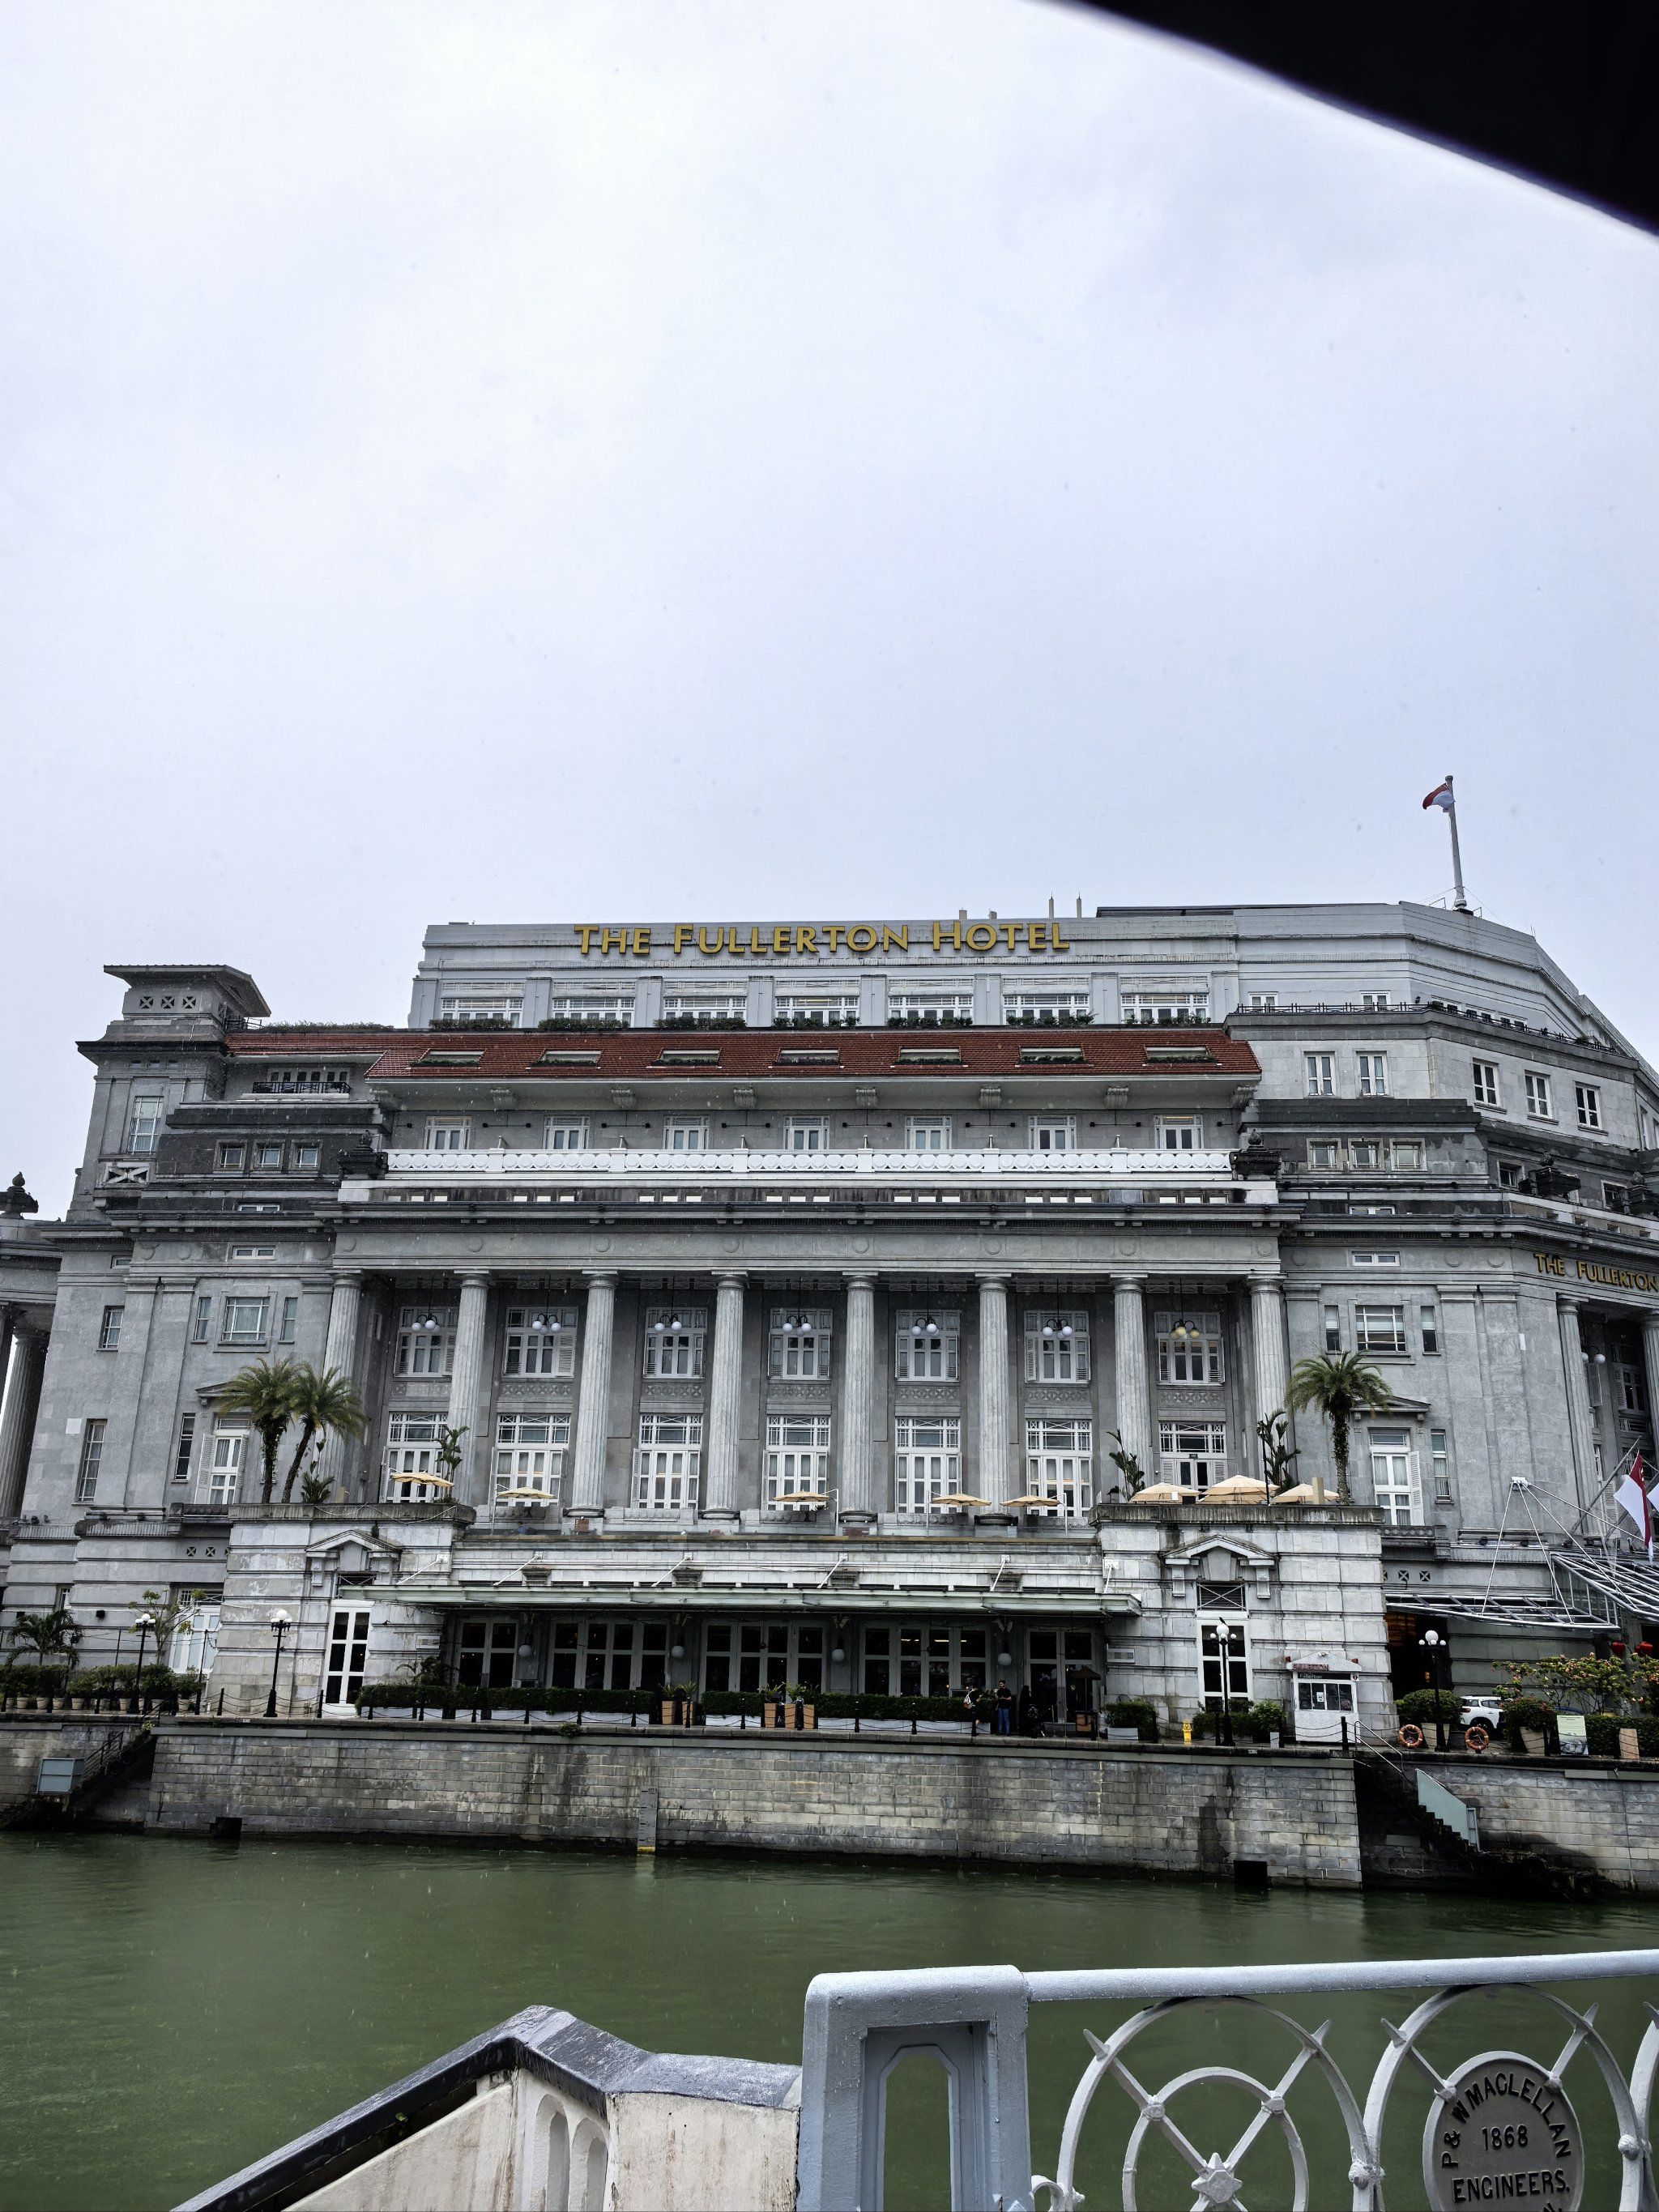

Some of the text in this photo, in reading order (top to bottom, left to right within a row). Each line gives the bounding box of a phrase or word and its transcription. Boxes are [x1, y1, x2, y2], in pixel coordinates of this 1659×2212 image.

[574, 921, 1071, 955] THE FULLERTON HOTEL
[1533, 1253, 1659, 1293] THE FULLERTON
[1441, 2072, 1572, 2168] P & W MACLELLAN
[1482, 2124, 1529, 2151] 1868
[1452, 2167, 1570, 2203] ENGINEERS.
